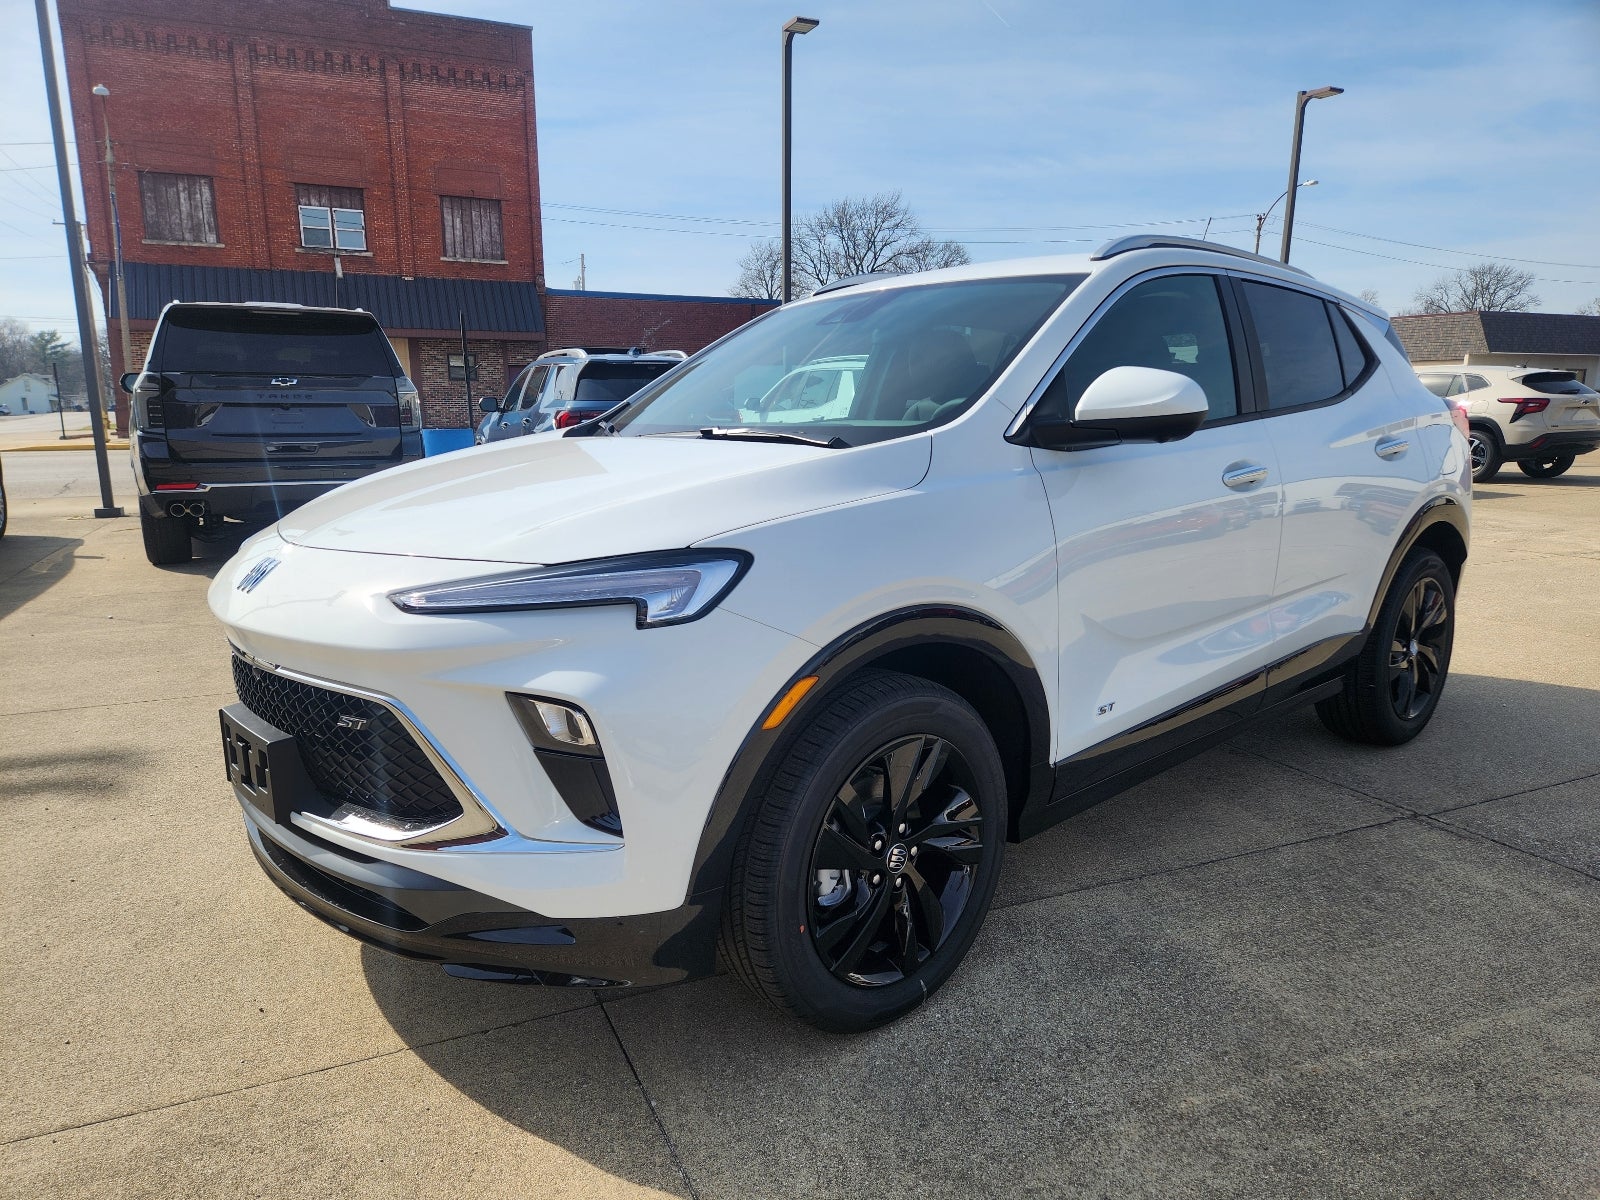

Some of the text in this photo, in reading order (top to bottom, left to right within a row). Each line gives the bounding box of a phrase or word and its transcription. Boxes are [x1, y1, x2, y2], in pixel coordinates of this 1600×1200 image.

[256, 392, 314, 400] TAHOE
[1097, 701, 1116, 716] ST
[336, 714, 367, 730] ST
